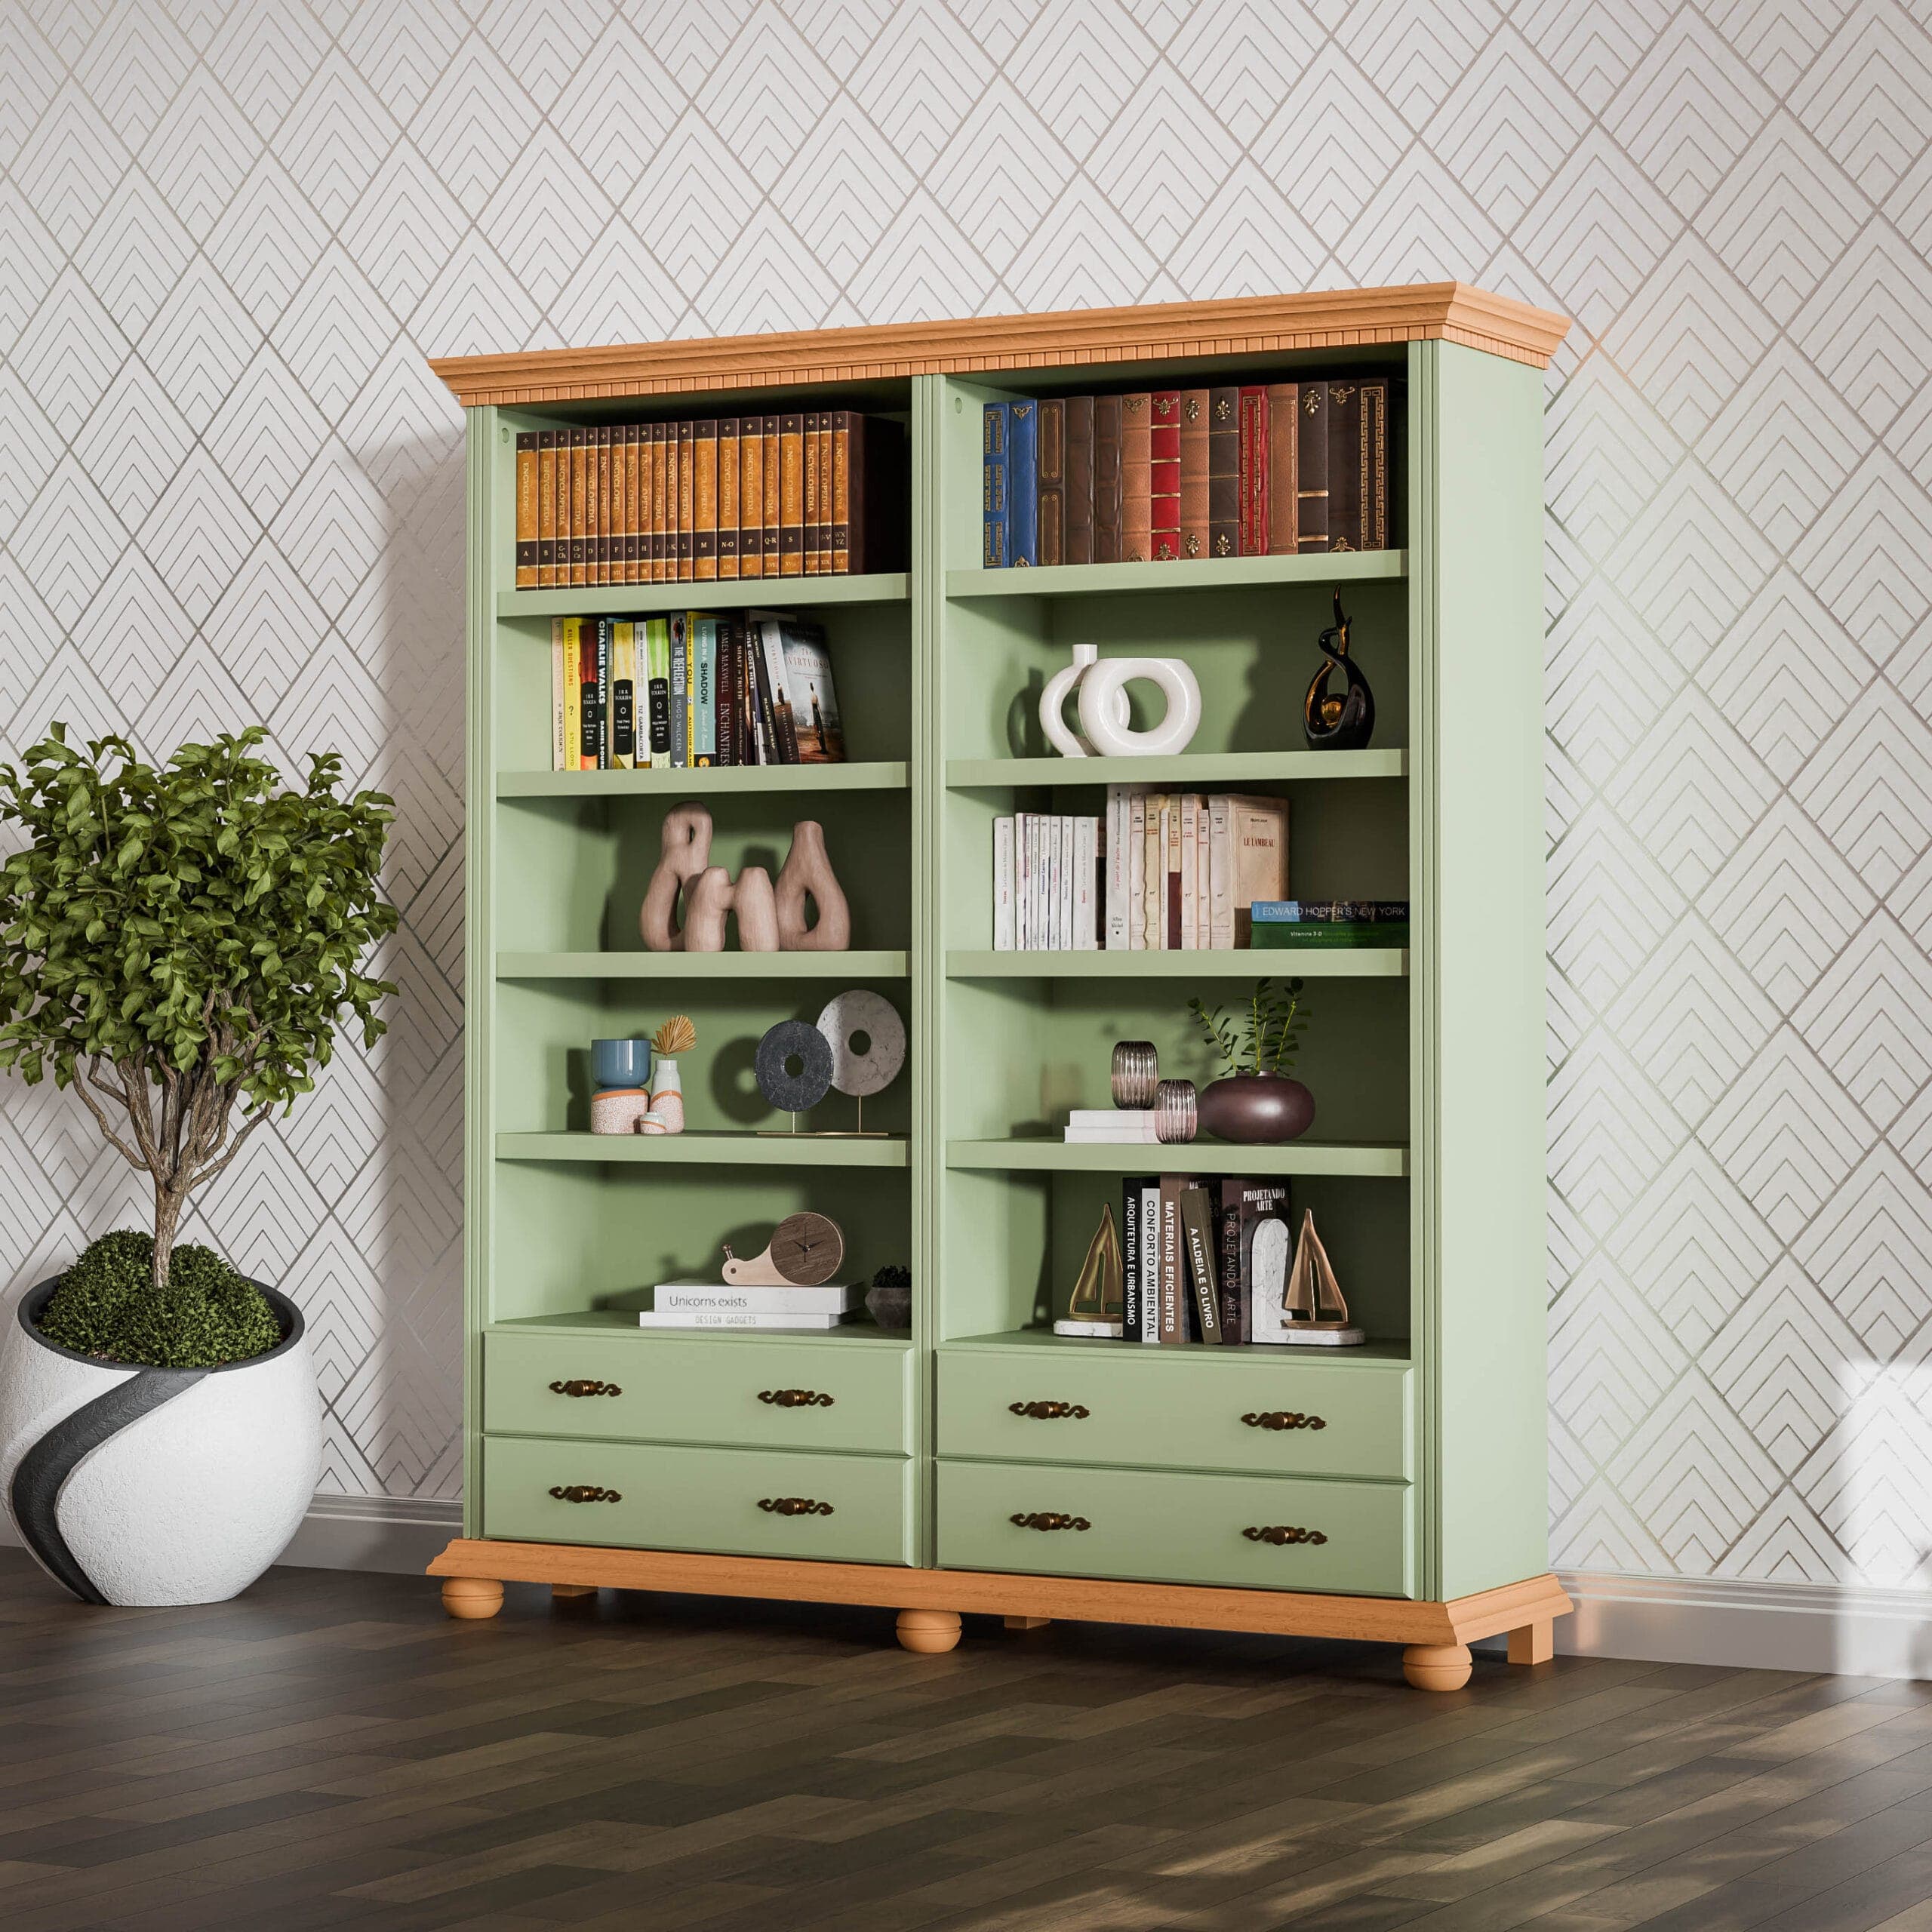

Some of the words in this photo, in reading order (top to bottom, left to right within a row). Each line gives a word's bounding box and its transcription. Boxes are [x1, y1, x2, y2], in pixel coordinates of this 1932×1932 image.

[674, 647, 684, 656] THE
[721, 629, 729, 653] JAMES
[673, 657, 685, 695] REFLECTION
[787, 656, 829, 669] VIRTUOSO
[1244, 837, 1250, 846] LE
[1251, 838, 1275, 848] LAMBEAU
[1263, 906, 1303, 916] EDWARD
[1306, 906, 1352, 916] HOPPER'S
[1355, 907, 1375, 916] NEW
[1379, 906, 1405, 916] YORK
[1243, 1188, 1285, 1202] PROJETANDO
[1256, 1200, 1273, 1211] ARTE
[1127, 1196, 1136, 1262] ARQUITETURA
[1146, 1200, 1155, 1266] CONFORTO
[1165, 1201, 1174, 1262] MATERIAIS
[1190, 1228, 1198, 1236] A
[1192, 1238, 1205, 1275] ALDEIA
[1226, 1213, 1236, 1288] PROJETANDO
[669, 1295, 716, 1307] Unicorns
[718, 1297, 748, 1308] exists
[1127, 1272, 1136, 1325] URBANSMO
[1146, 1269, 1155, 1337] AMBIENTAL
[1165, 1266, 1174, 1332] EFICIENTES
[1201, 1297, 1214, 1328] LIVRO
[1226, 1296, 1236, 1325] ARTE
[695, 1315, 721, 1324] DESIGN
[726, 1315, 757, 1324] GADGETS
